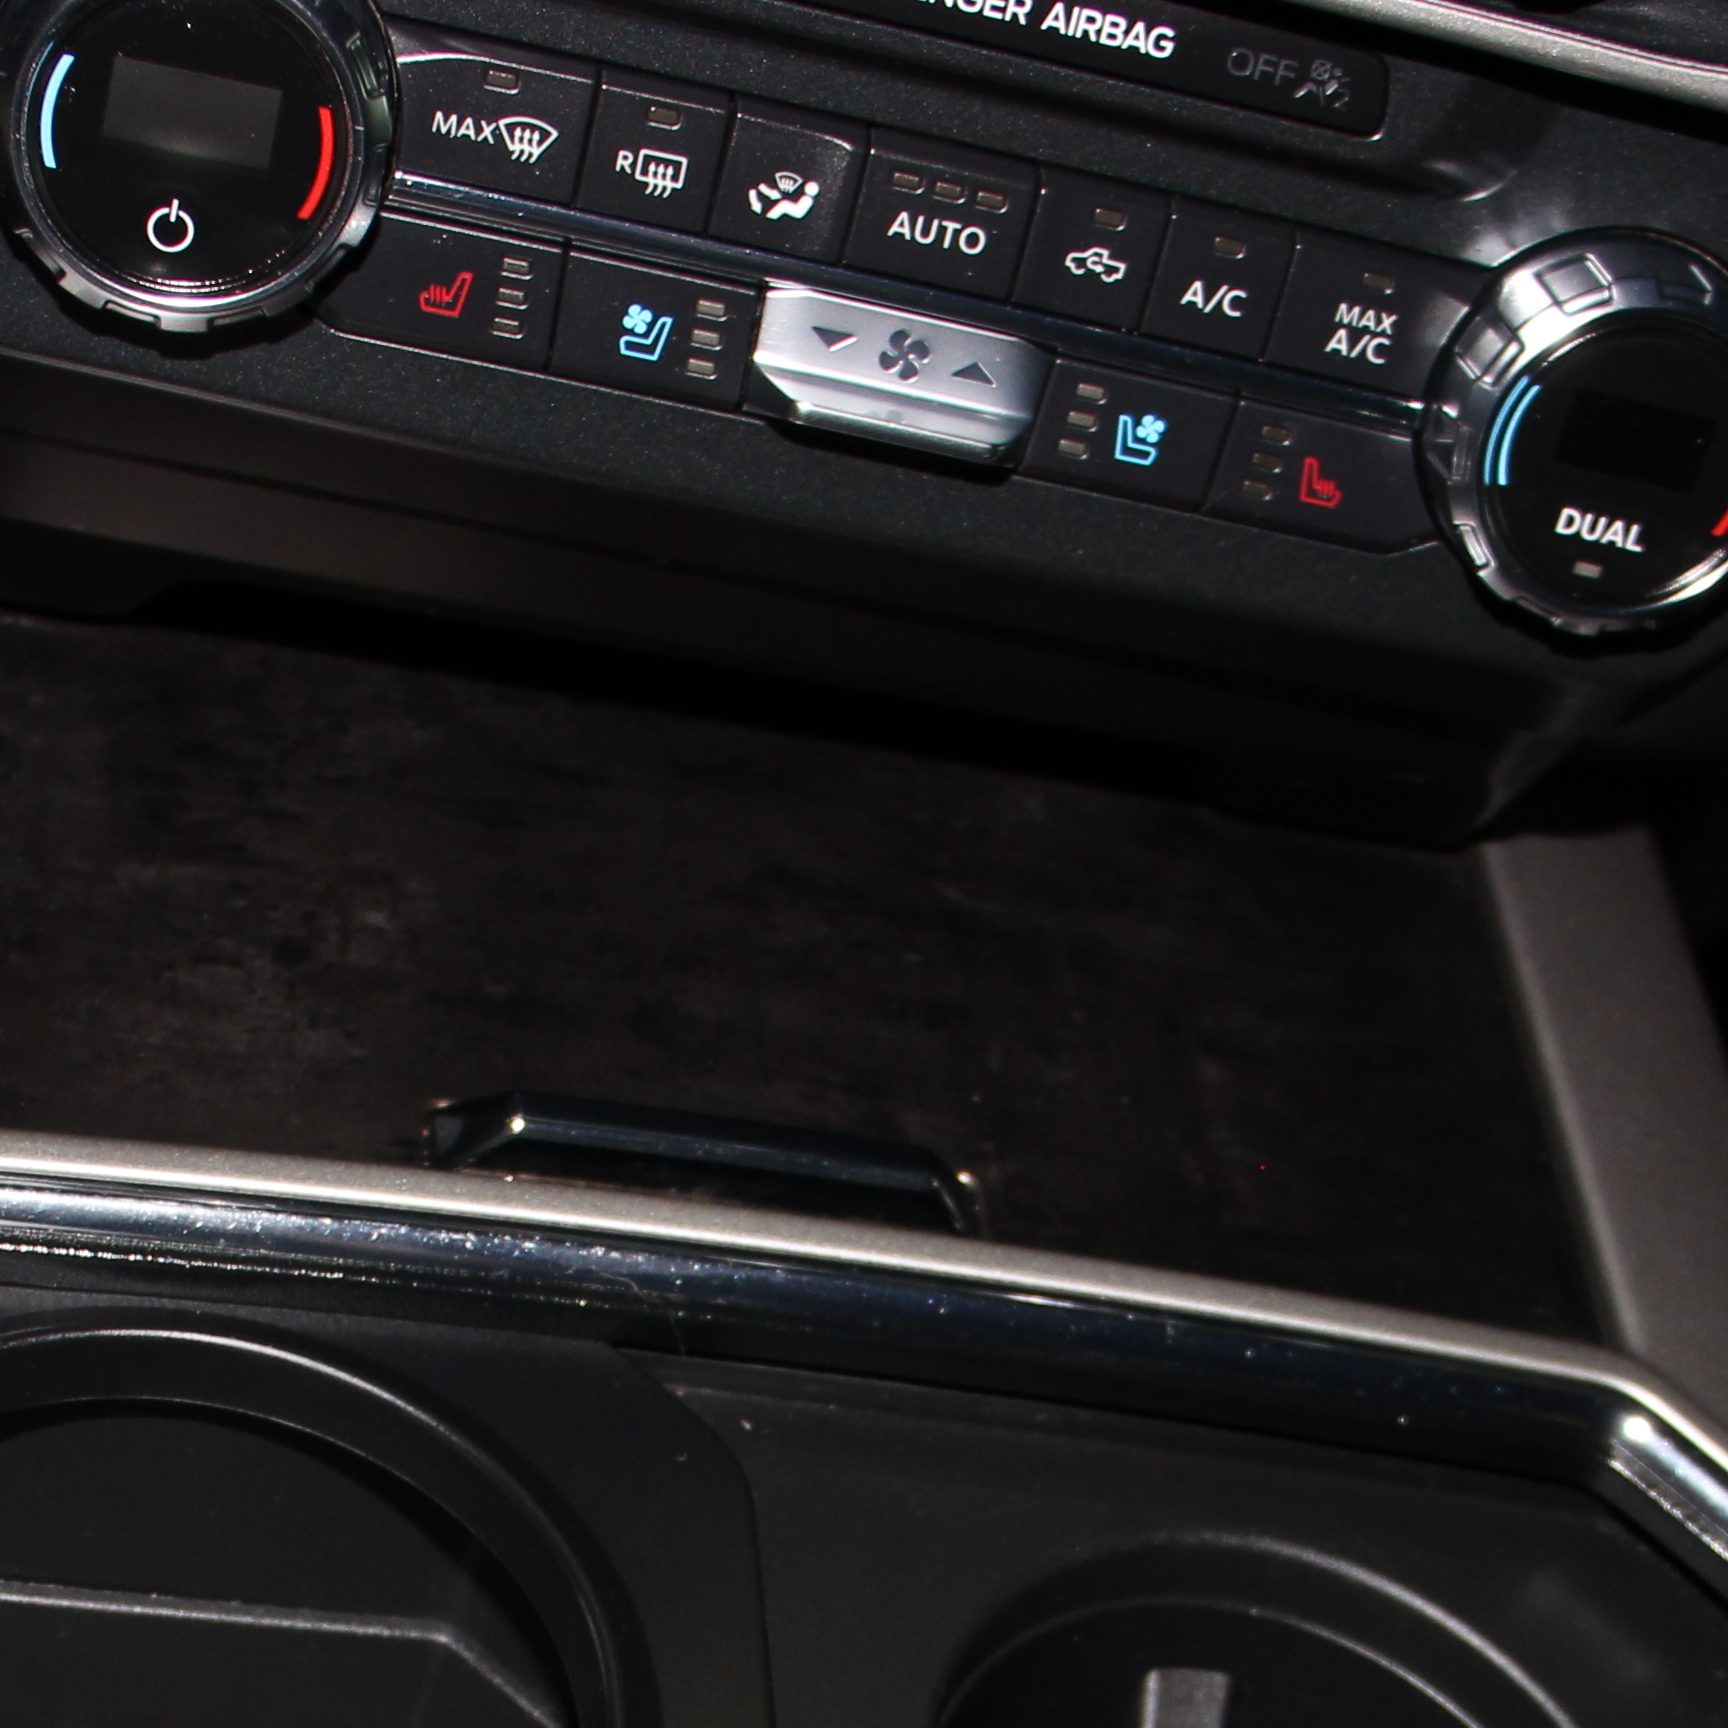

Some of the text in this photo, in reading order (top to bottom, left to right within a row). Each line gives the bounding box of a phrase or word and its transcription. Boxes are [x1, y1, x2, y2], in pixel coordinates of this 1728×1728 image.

[1041, 1, 1175, 58] AIRBAG
[1227, 47, 1298, 85] OFF
[432, 111, 495, 144] MAX
[615, 148, 633, 174] R
[887, 210, 986, 255] AUTO
[1180, 280, 1247, 318] A/C
[1335, 303, 1398, 336] MAX
[1325, 332, 1391, 365] A/C
[1555, 507, 1643, 553] DUAL
